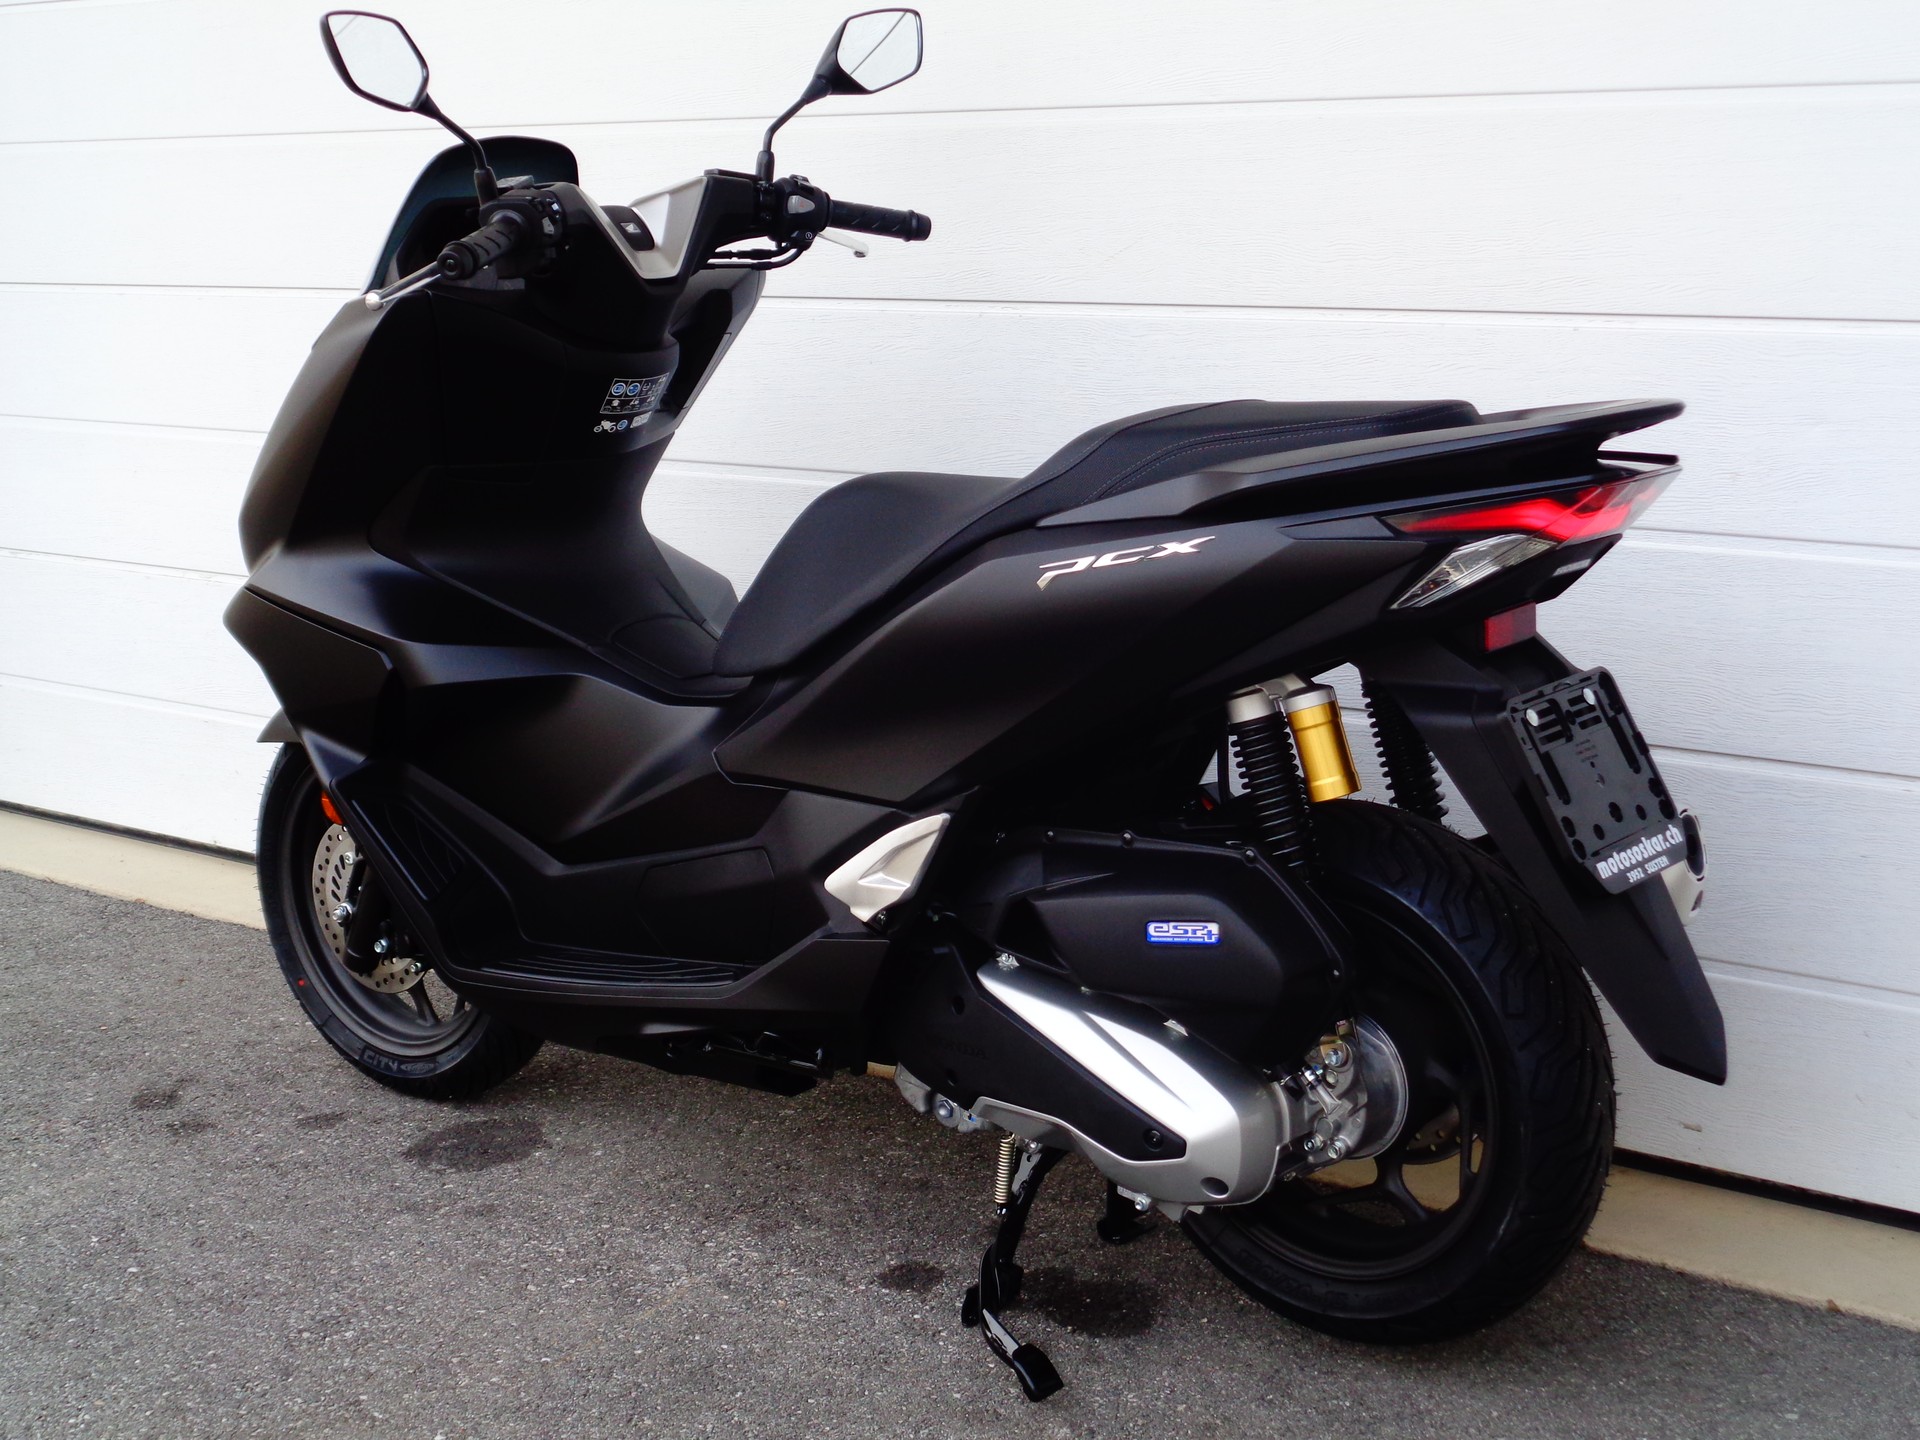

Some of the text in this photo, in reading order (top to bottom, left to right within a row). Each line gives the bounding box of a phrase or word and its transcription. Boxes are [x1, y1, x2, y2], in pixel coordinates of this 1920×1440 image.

[1036, 535, 1216, 591] PCX
[1595, 824, 1683, 879] motososkar.ch
[363, 1049, 399, 1072] CITY
